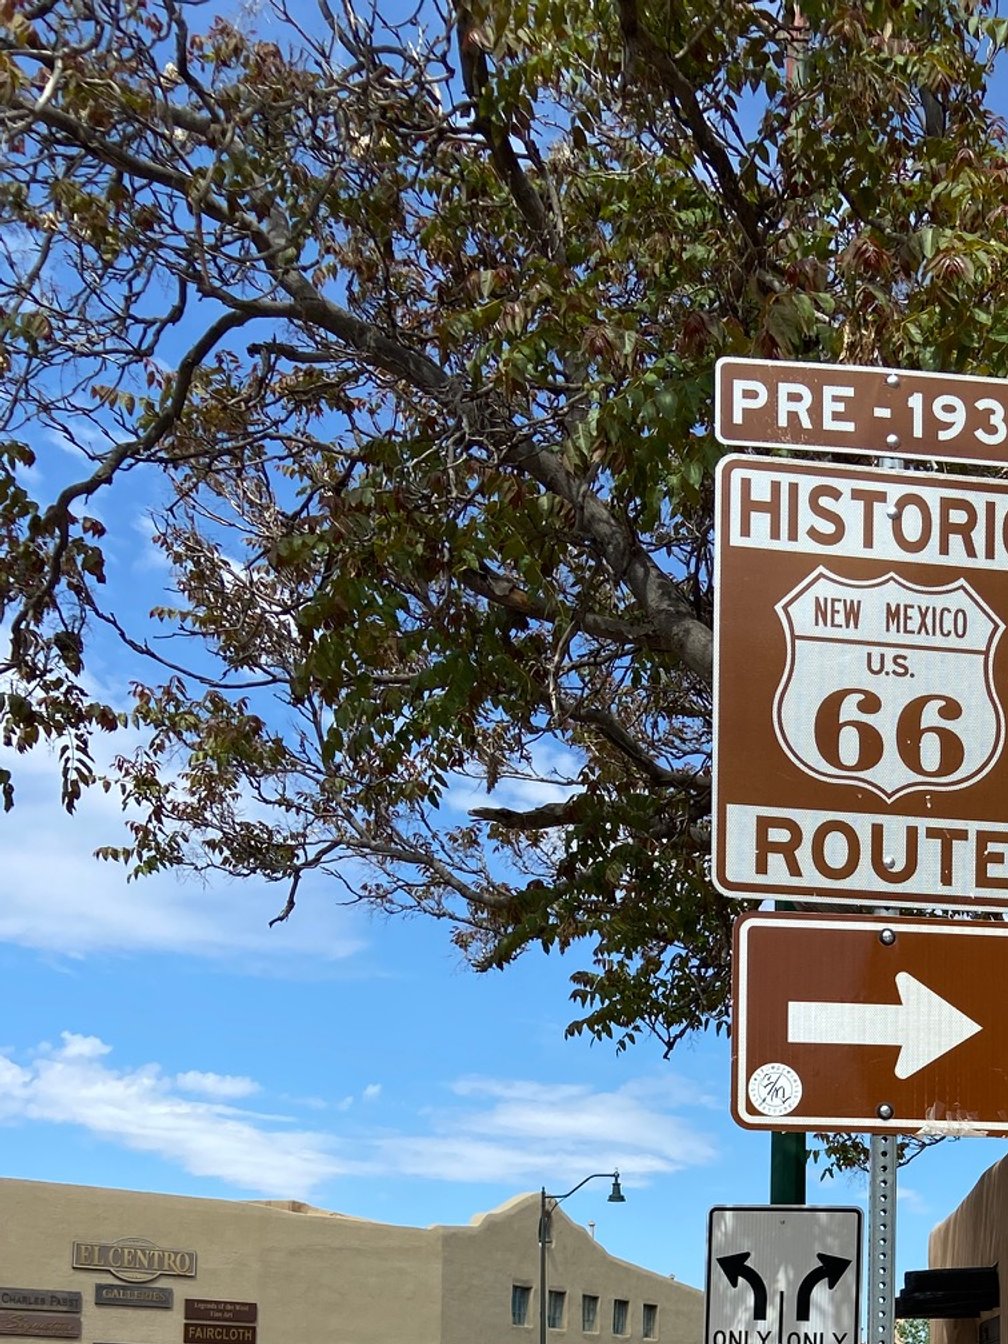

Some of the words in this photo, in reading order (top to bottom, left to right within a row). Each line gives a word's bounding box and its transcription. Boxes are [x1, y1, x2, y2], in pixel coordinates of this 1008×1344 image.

[731, 378, 856, 432] PRE
[813, 596, 862, 630] NEW
[885, 602, 969, 640] MEXICO
[866, 651, 916, 679] U.S.
[813, 687, 966, 779] 66
[80, 1245, 104, 1265] EL
[108, 1247, 191, 1275] CENTRO
[1, 1292, 46, 1306] CHARLES
[102, 1288, 166, 1301] GALLERIES
[189, 1326, 252, 1341] FAIRCLOTH
